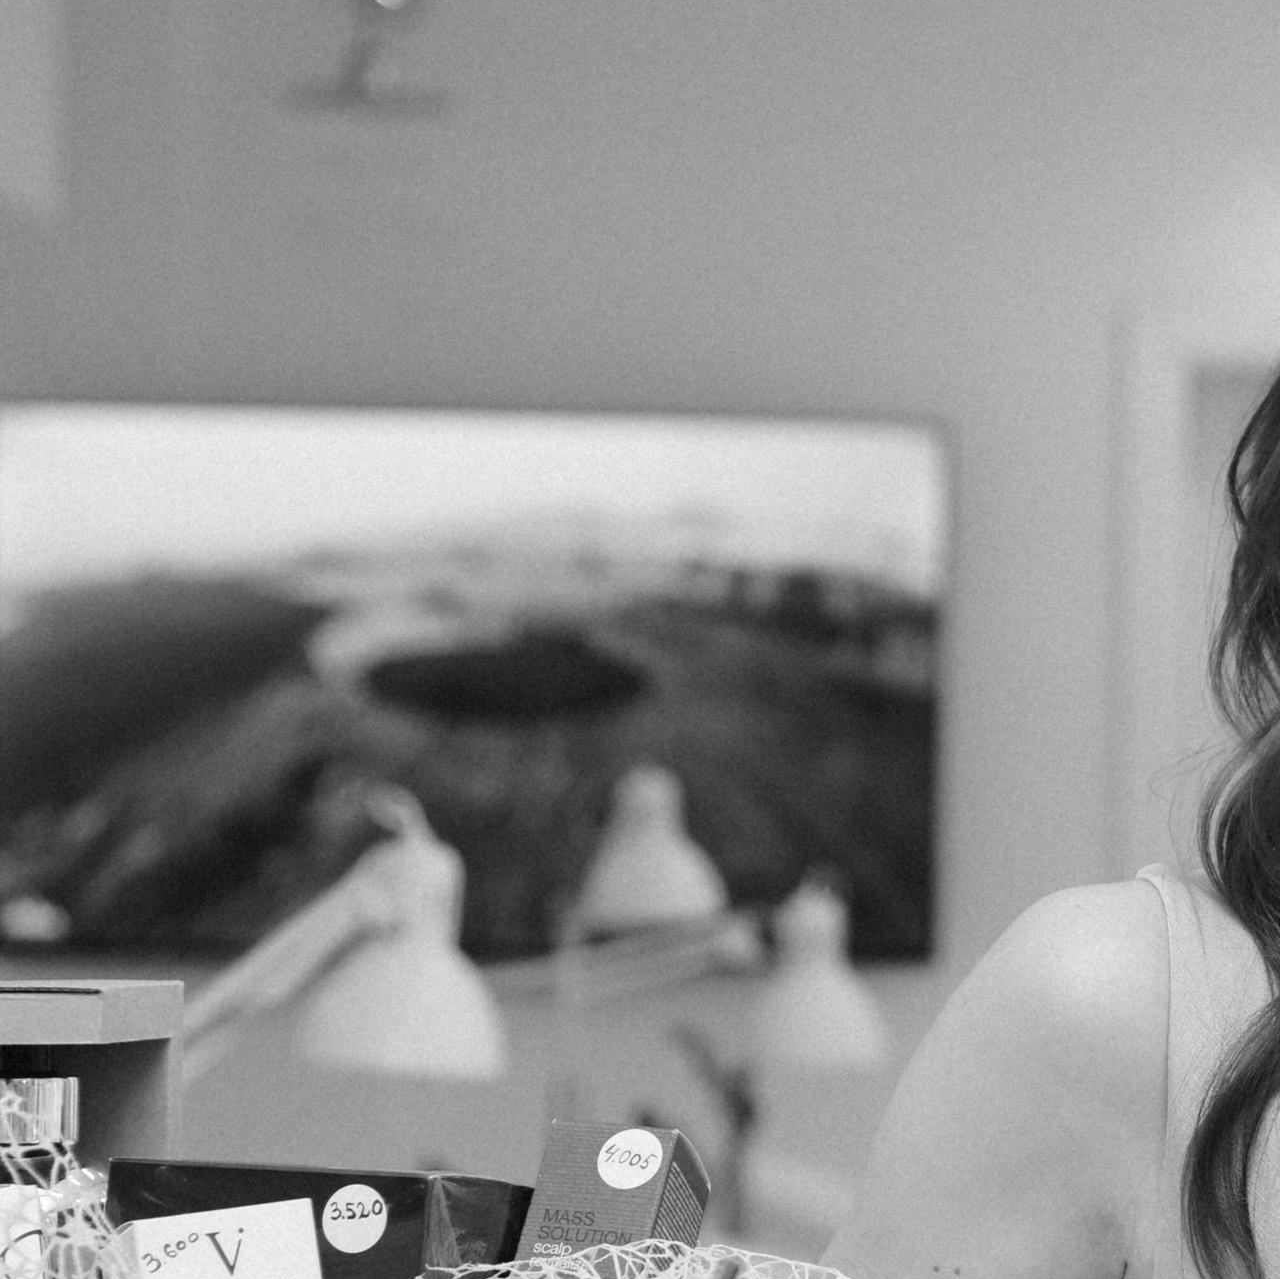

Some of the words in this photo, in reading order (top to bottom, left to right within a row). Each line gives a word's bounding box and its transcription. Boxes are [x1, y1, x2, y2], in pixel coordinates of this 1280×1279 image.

[604, 1143, 658, 1169] 4.005
[330, 1199, 383, 1220] 3.520
[543, 1208, 596, 1227] MASS
[537, 1225, 633, 1245] SOLUTION
[141, 1232, 200, 1273] 3.600
[533, 1242, 572, 1256] scalp
